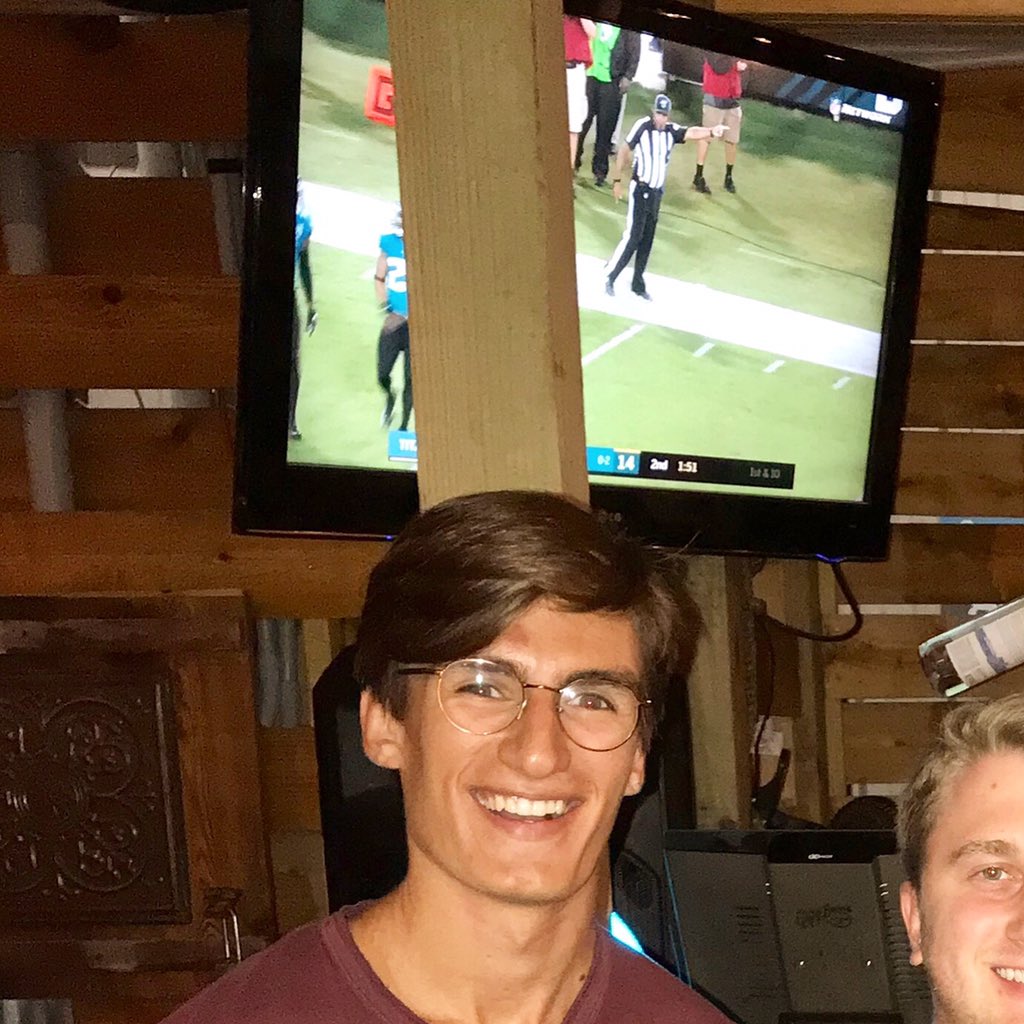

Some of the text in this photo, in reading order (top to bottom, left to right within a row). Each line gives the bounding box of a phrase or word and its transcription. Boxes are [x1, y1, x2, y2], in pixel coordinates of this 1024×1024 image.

[616, 454, 636, 471] 14
[650, 458, 698, 473] 2nd 1:51
[750, 467, 761, 478] 1st
[771, 468, 781, 479] 10
